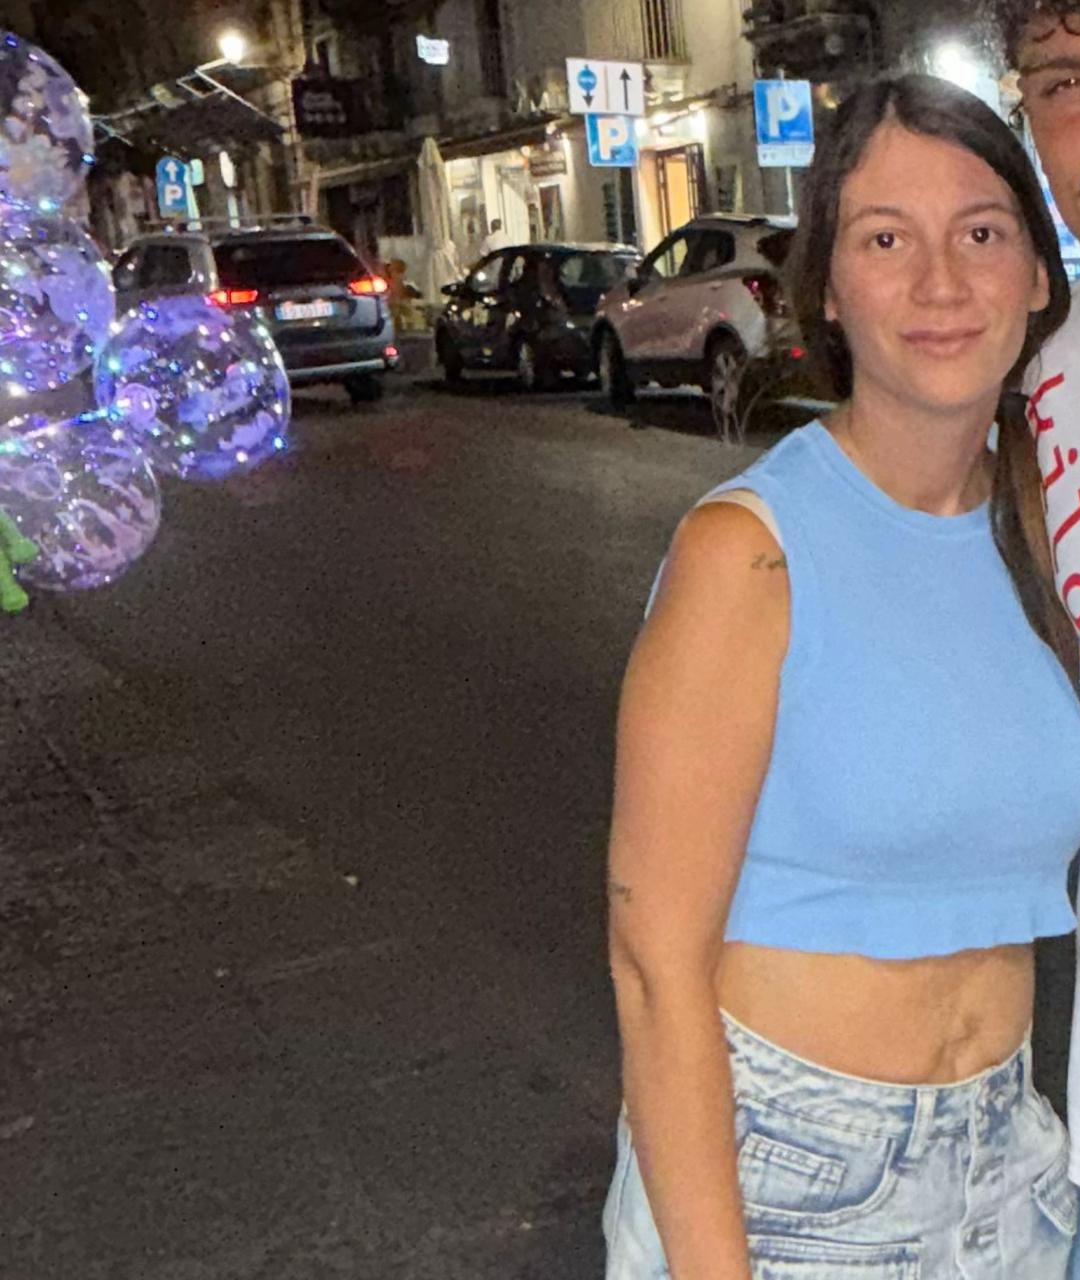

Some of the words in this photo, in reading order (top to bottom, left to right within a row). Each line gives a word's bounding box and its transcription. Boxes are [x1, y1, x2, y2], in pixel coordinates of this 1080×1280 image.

[766, 87, 799, 137] P
[597, 117, 628, 160] P
[164, 183, 183, 207] P
